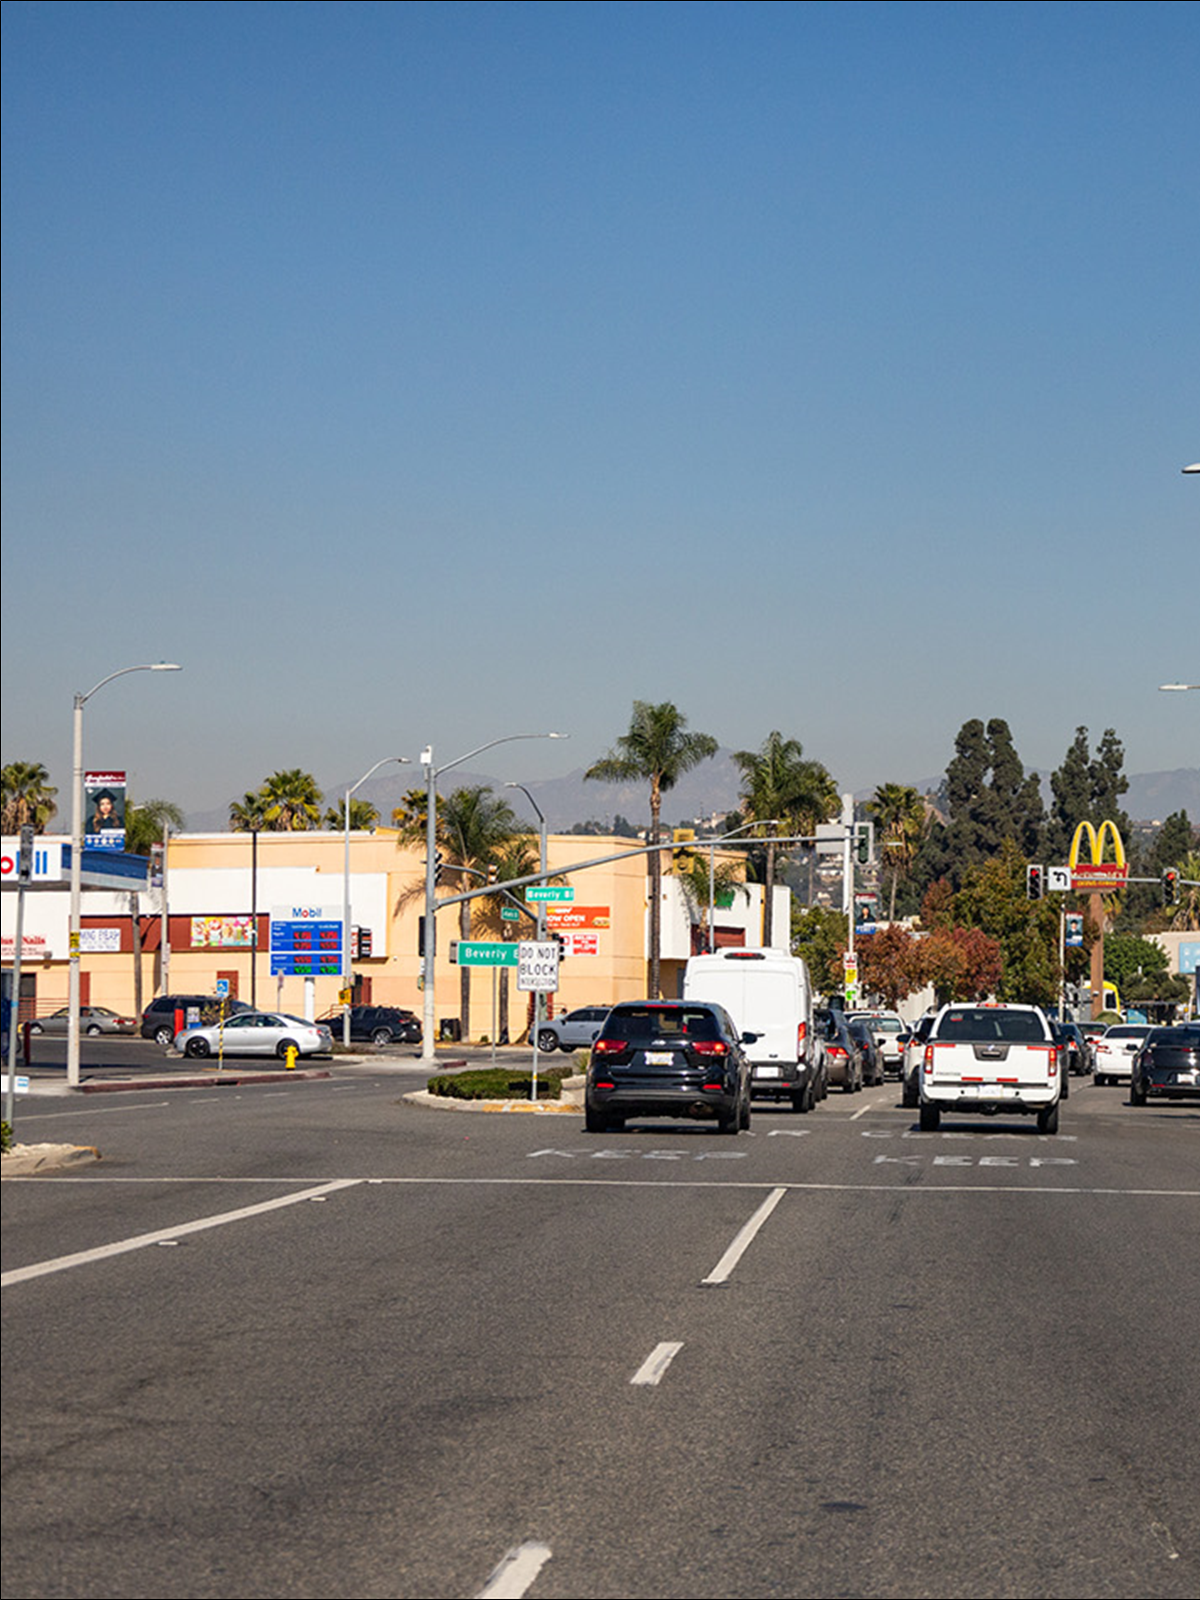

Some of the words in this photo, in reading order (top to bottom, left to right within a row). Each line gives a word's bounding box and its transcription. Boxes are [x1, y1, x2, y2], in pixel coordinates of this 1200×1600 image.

[1, 850, 48, 875] oil
[528, 889, 560, 900] Beverly
[292, 907, 322, 918] Mobil
[465, 948, 508, 960] Beverly
[519, 947, 534, 959] DO
[537, 947, 556, 959] NOT
[519, 963, 557, 976] BLOCK
[870, 1154, 1081, 1168] KEEP
